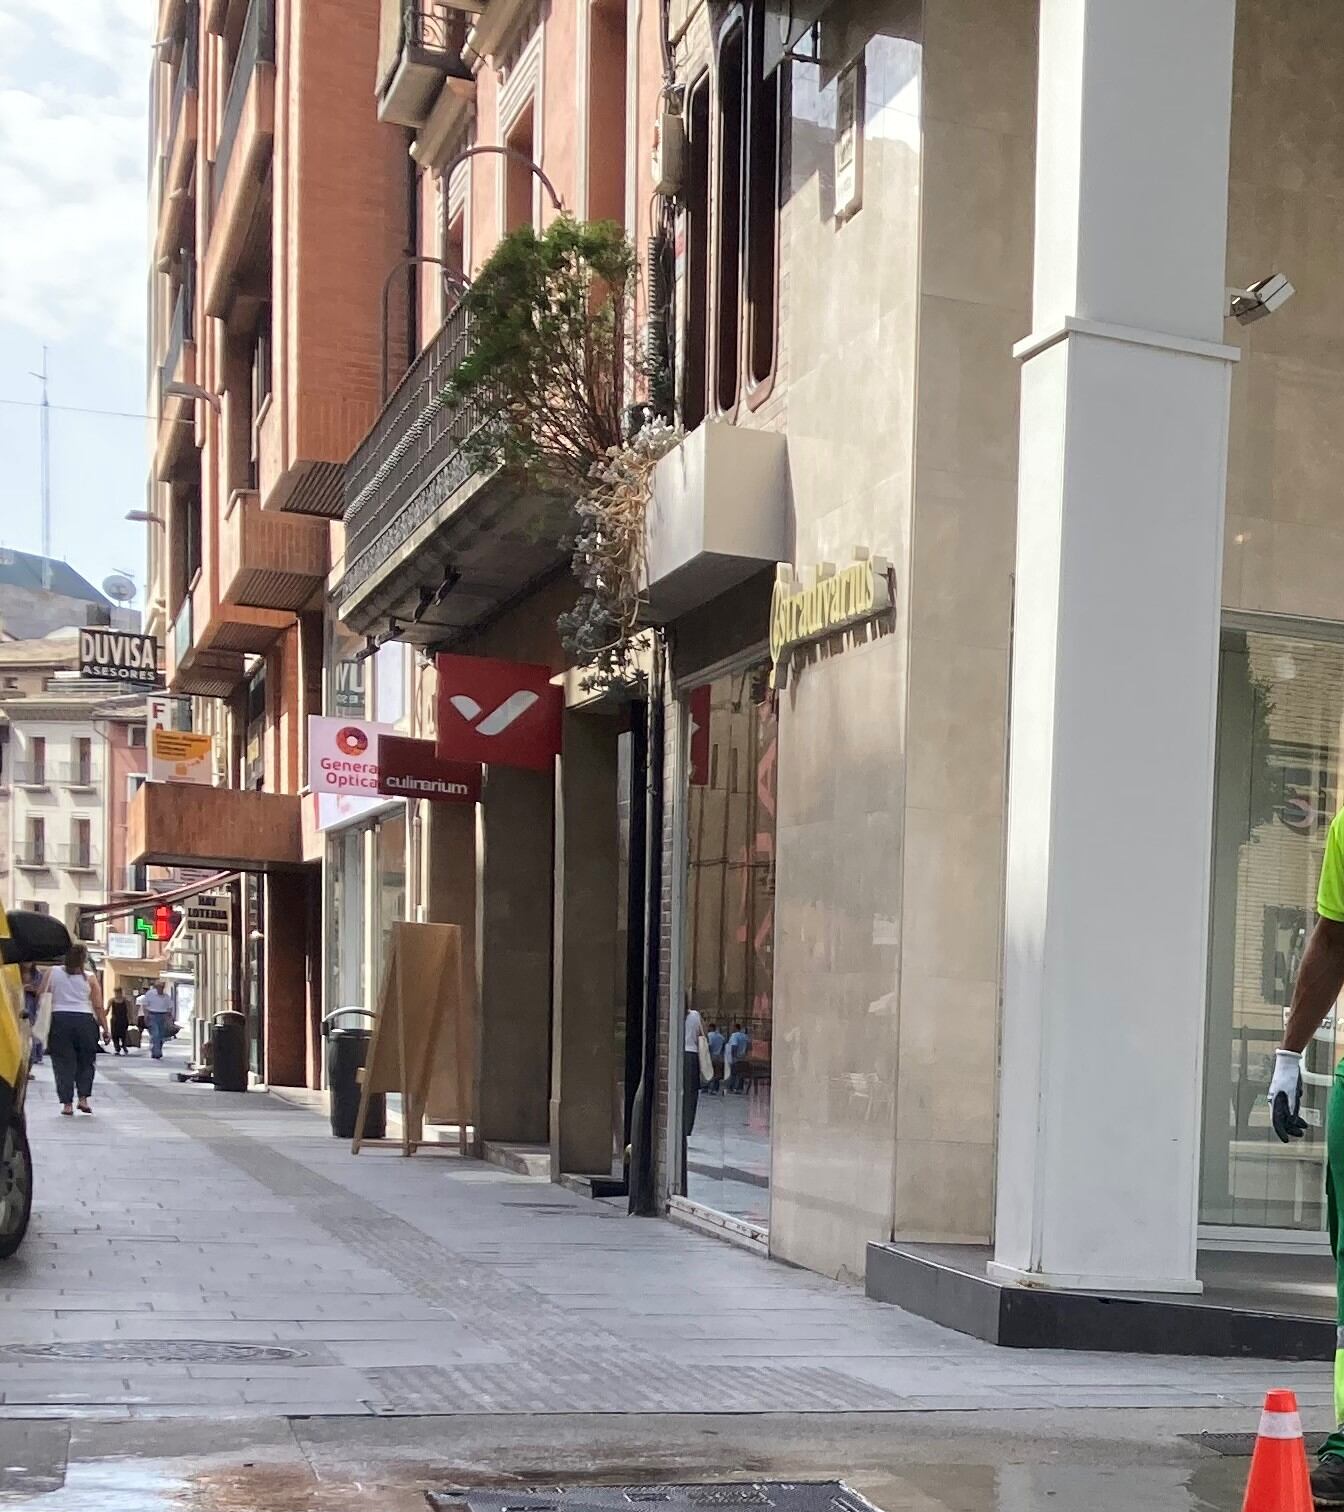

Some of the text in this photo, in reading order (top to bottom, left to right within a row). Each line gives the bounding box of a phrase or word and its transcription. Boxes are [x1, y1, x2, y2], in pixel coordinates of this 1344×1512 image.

[81, 632, 155, 669] DUVISA
[82, 664, 156, 681] ASESORES
[326, 772, 378, 788] Optica
[386, 775, 468, 795] culinarium
